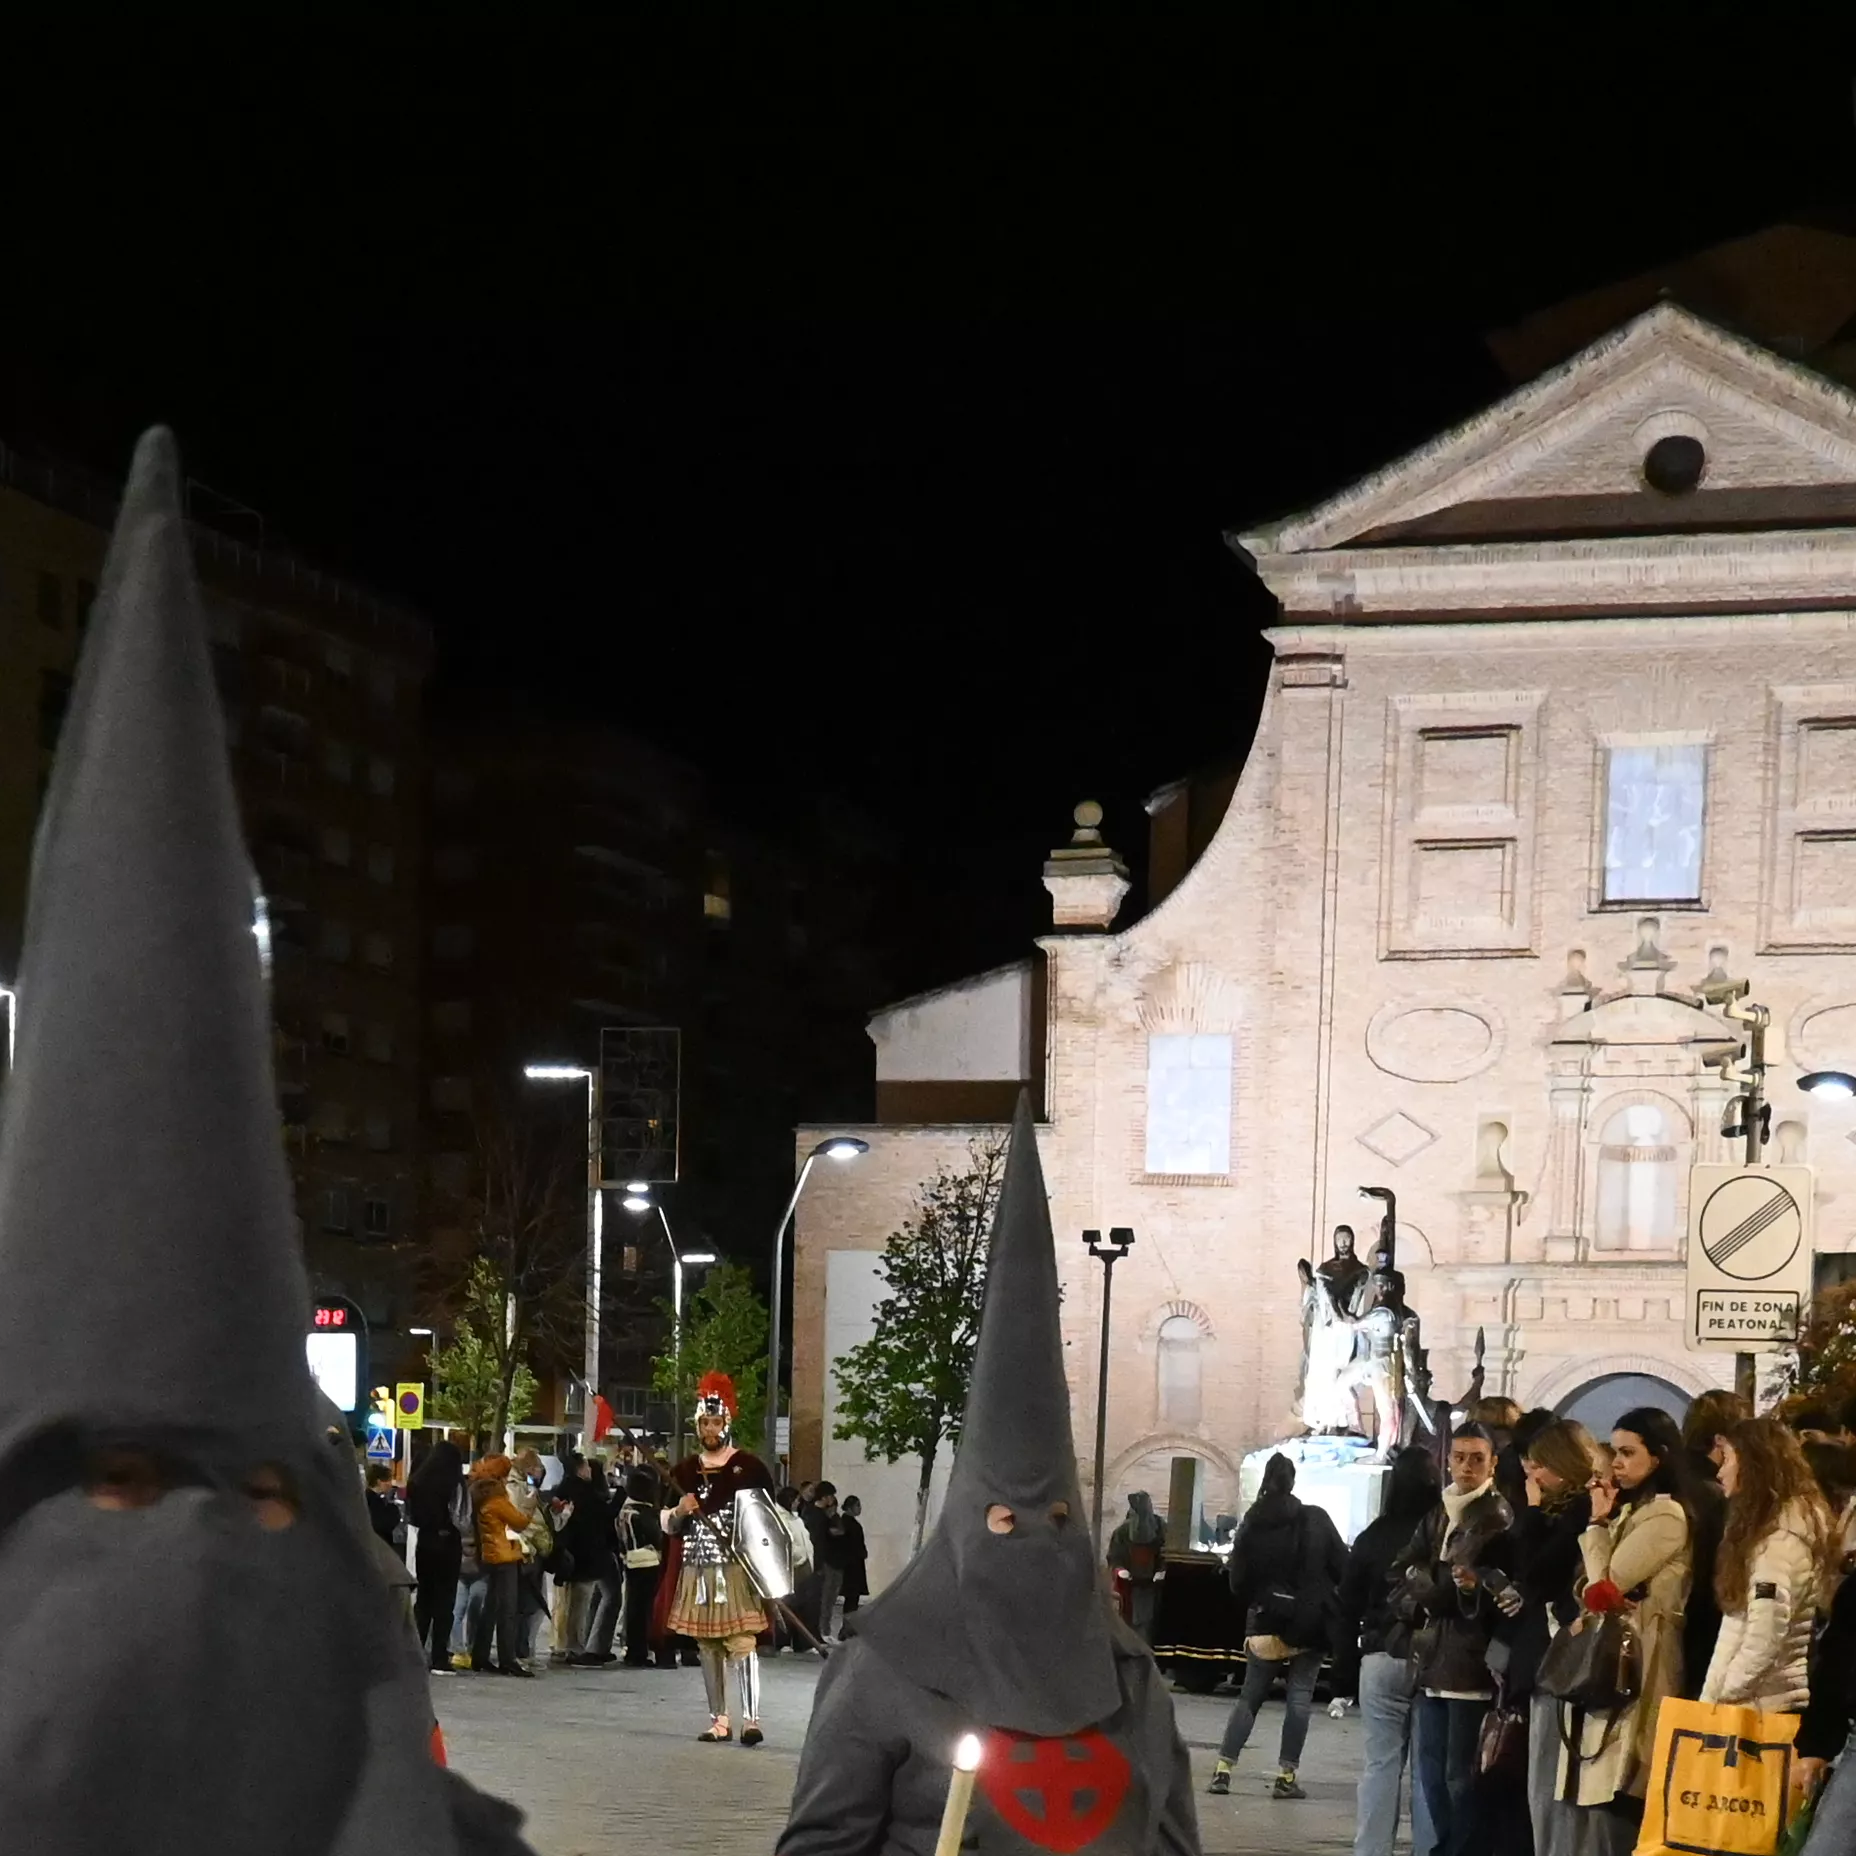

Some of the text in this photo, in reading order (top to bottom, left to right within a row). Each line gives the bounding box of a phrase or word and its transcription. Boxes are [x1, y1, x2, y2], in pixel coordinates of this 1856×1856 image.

[1702, 1301, 1794, 1313] FIN DE ZONA
[1709, 1318, 1786, 1330] PEATONAL
